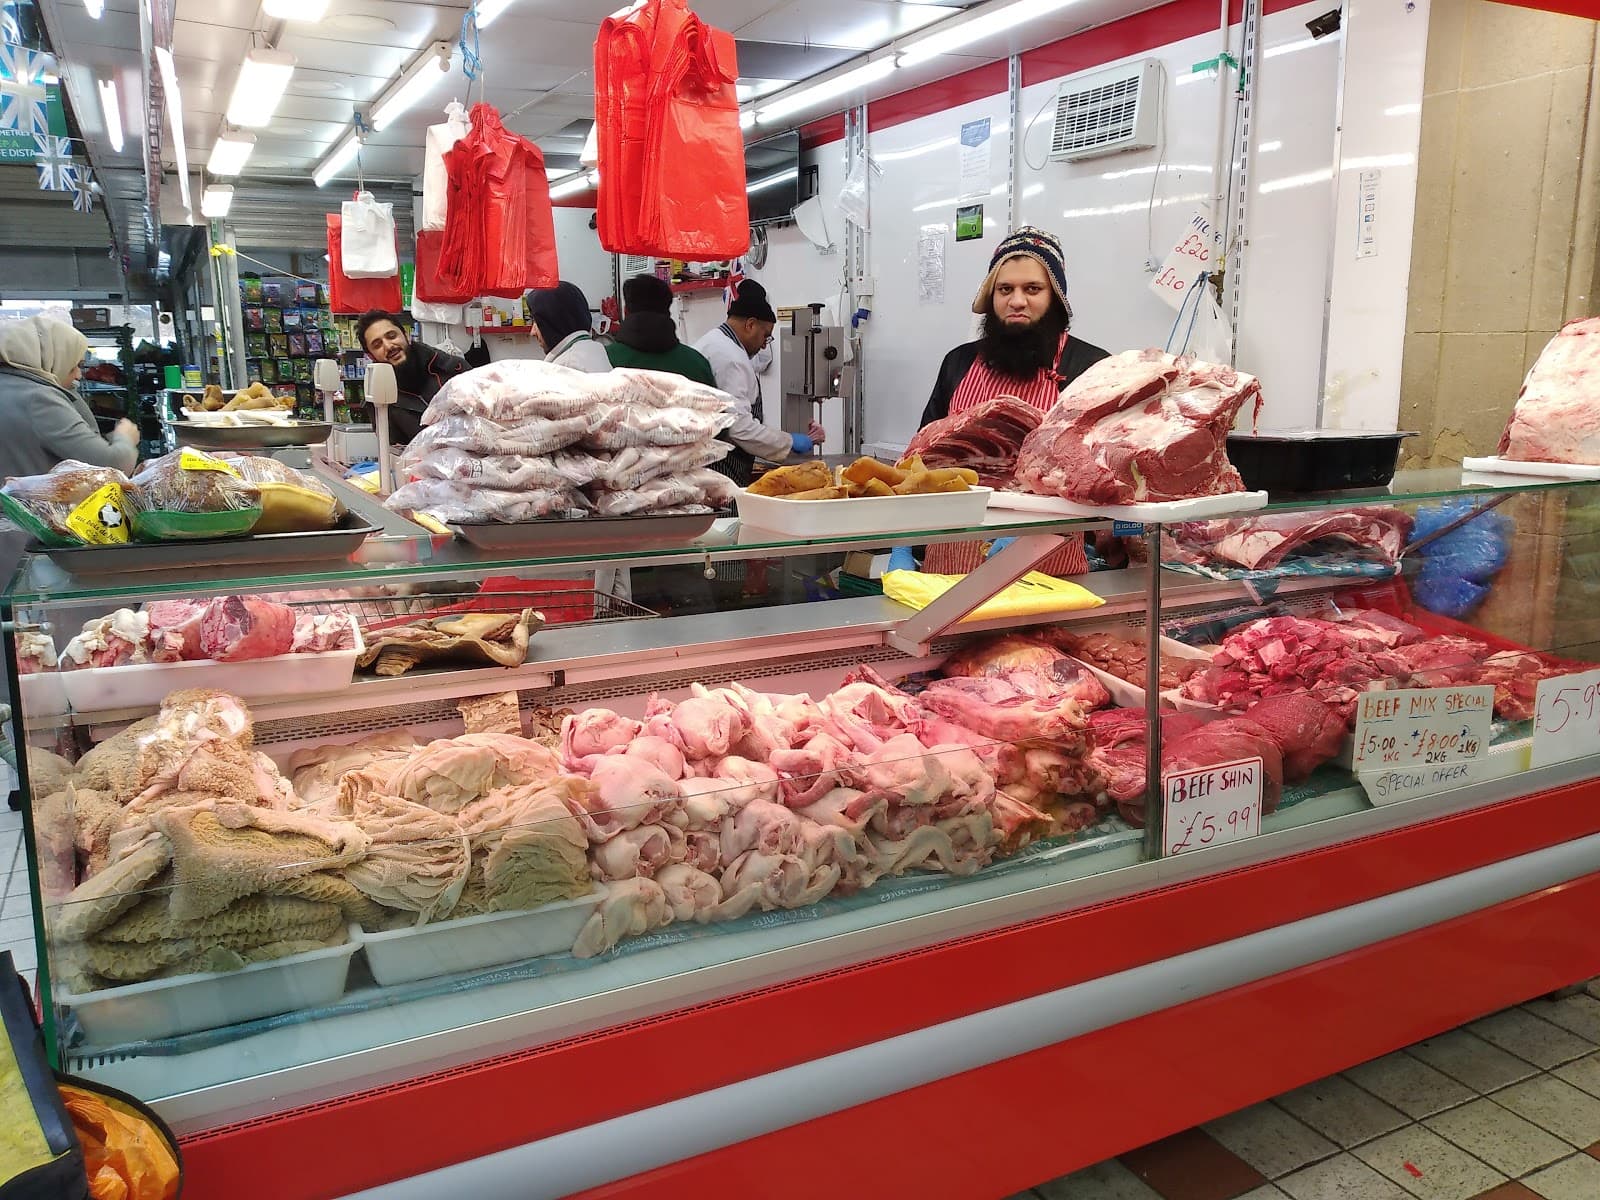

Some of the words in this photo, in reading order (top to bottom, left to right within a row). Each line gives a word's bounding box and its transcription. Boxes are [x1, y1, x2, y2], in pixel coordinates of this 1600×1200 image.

[1155, 267, 1185, 290] £10
[1363, 696, 1401, 720] BEEF
[1409, 694, 1438, 715] MIX
[1445, 692, 1489, 712] SPECIAL
[1356, 727, 1397, 761] £5.00
[1424, 750, 1448, 764] 2KG
[1171, 773, 1215, 804] BEEF
[1219, 768, 1254, 791] SHIN
[1375, 774, 1425, 797] SPECIAL
[1431, 764, 1470, 783] OFFER
